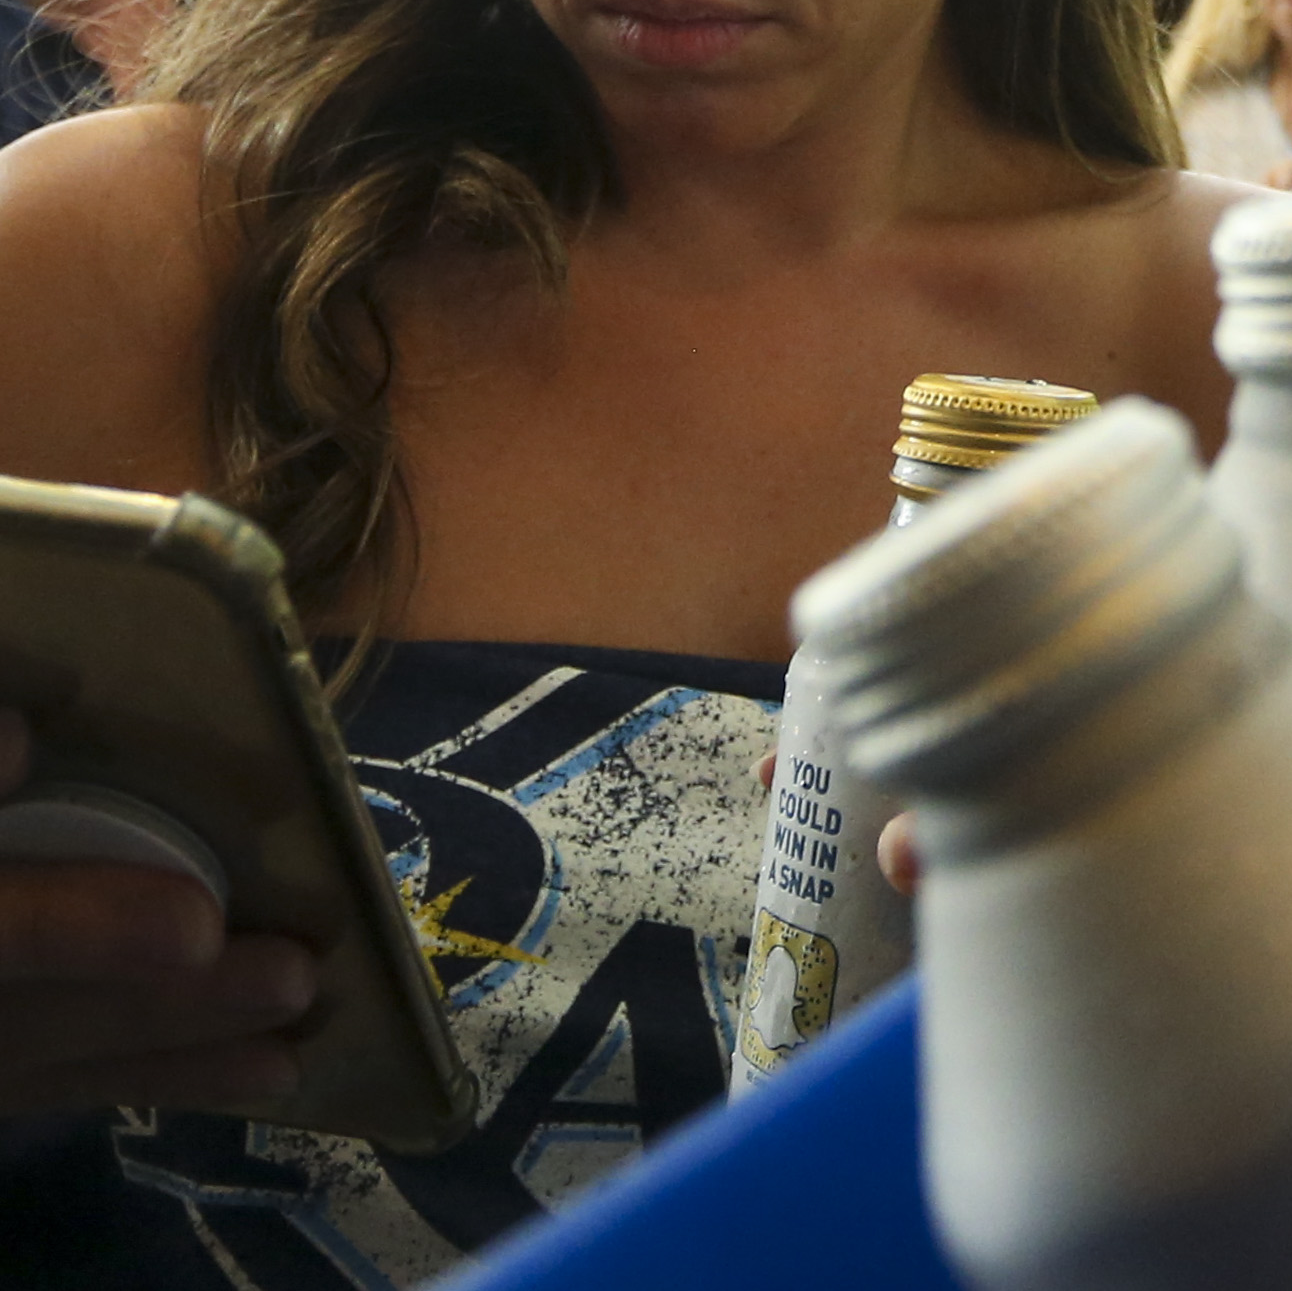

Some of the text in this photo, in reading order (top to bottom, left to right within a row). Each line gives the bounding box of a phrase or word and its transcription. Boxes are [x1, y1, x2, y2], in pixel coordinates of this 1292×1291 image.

[793, 757, 831, 795] YOU
[779, 788, 842, 835] COULD
[774, 821, 838, 873] WIN IN
[769, 858, 835, 904] A SNAP
